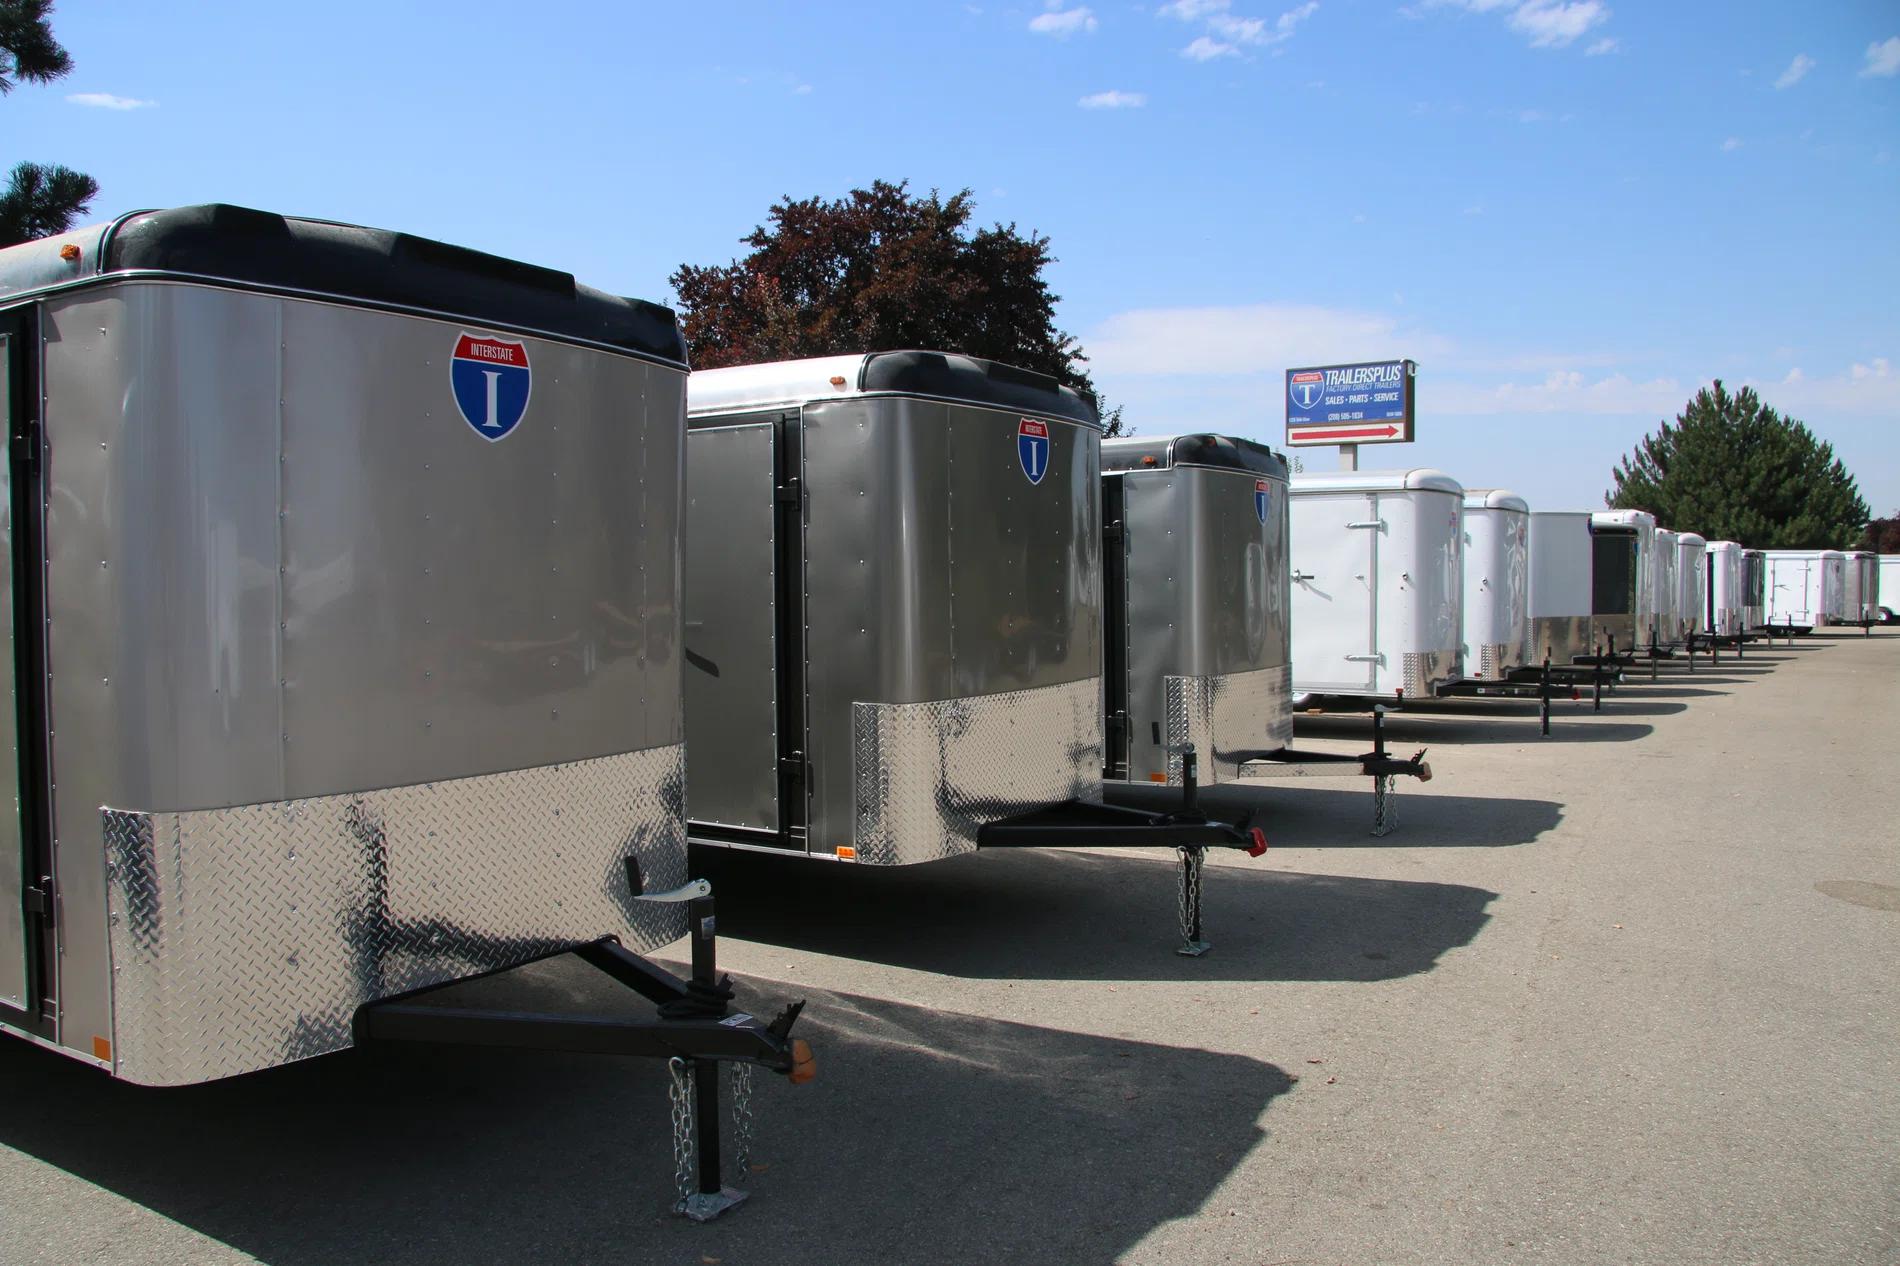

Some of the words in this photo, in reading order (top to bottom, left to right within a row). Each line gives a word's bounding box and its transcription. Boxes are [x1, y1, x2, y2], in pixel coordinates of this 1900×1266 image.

[471, 343, 513, 361] INTERSTATE
[1325, 365, 1401, 385] TRAILERSPLUS
[1299, 384, 1315, 404] T
[1353, 383, 1373, 391] DIRECT
[1374, 380, 1401, 389] TRAILERS
[481, 370, 502, 428] I
[1325, 396, 1344, 405] SALES
[1349, 394, 1369, 403] PARTS
[1373, 392, 1399, 402] SERVICE
[1030, 441, 1039, 475] I
